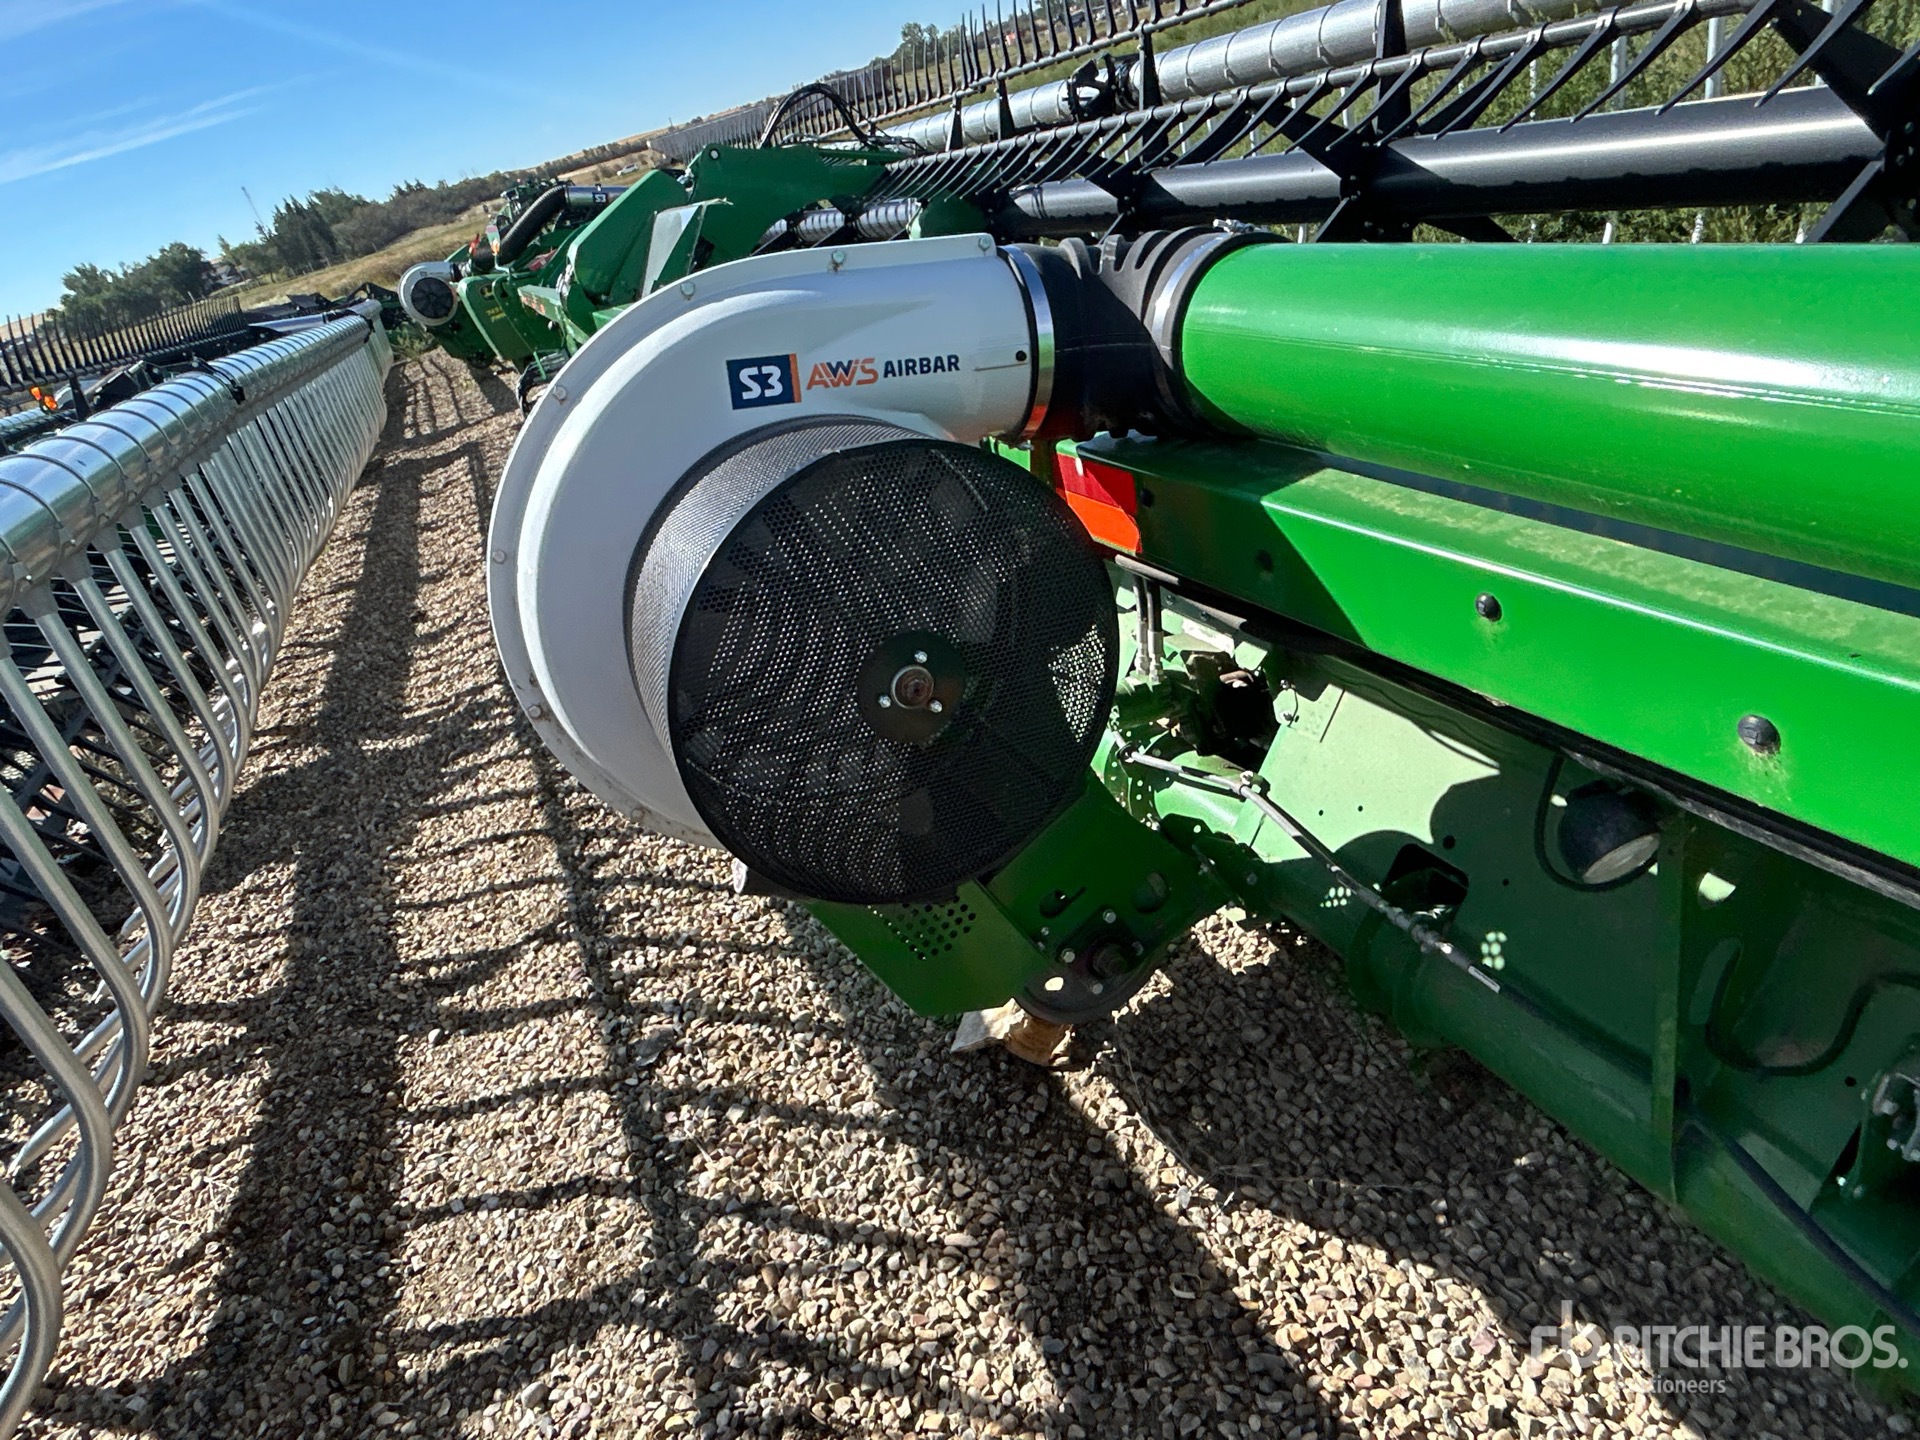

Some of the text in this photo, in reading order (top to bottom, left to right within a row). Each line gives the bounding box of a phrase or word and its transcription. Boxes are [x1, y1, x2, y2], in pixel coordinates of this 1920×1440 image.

[738, 354, 960, 400] S3 AWS AIRBAR
